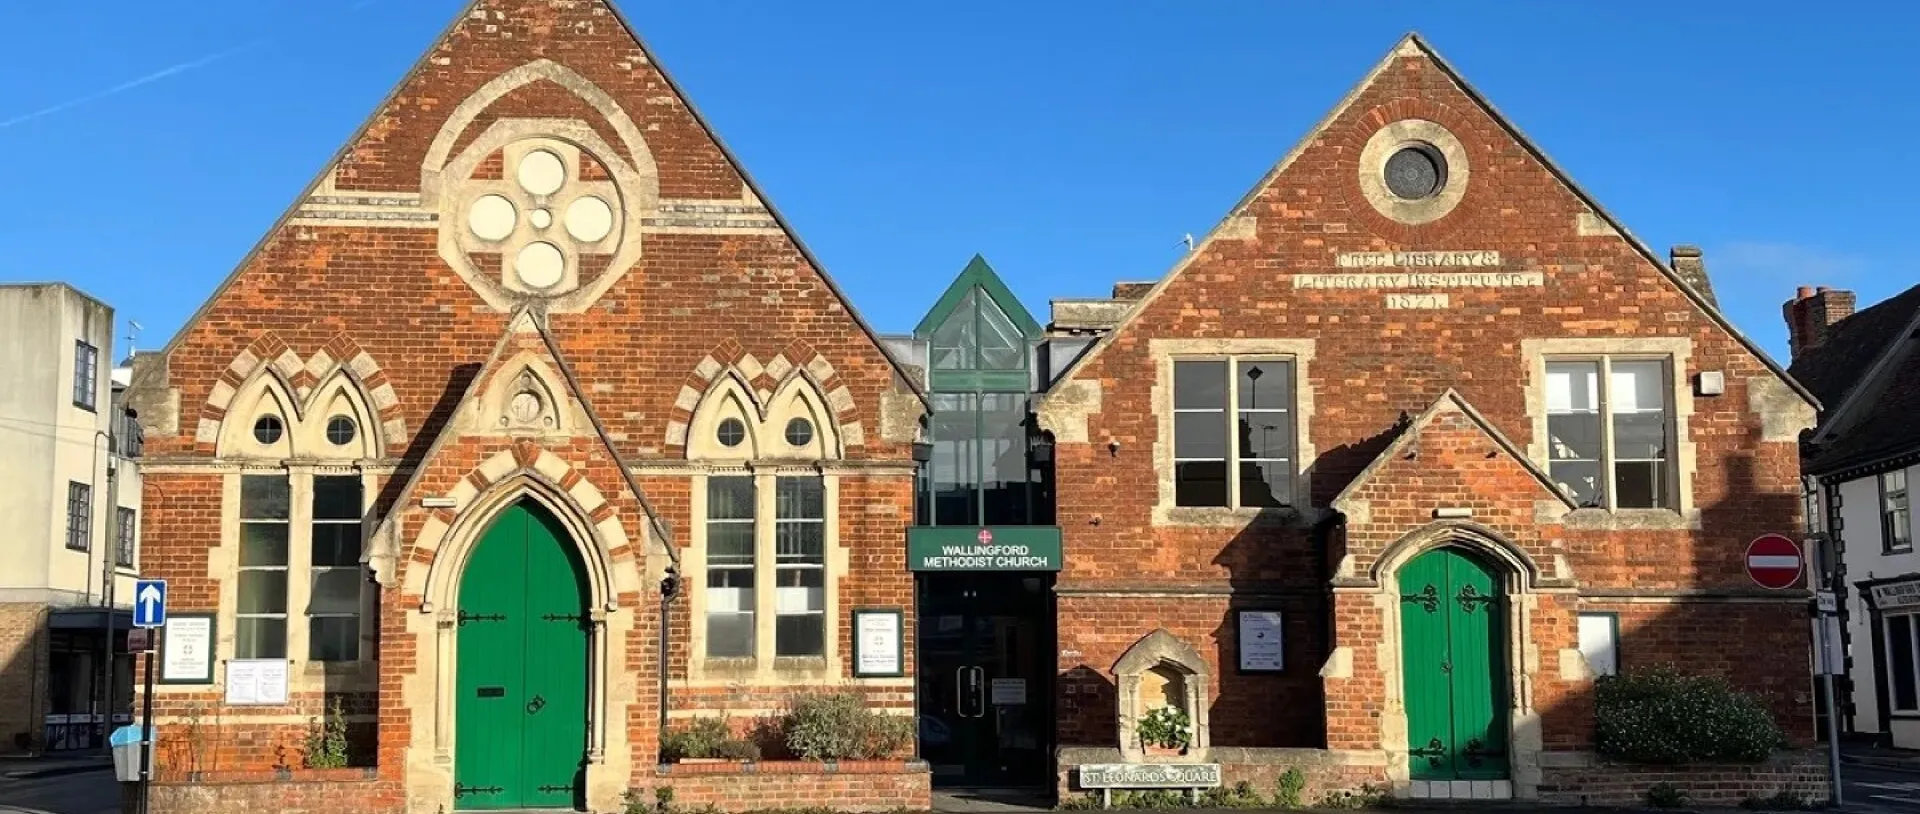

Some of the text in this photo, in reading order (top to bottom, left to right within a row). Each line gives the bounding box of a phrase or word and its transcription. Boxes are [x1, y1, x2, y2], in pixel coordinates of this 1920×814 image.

[1393, 252, 1476, 266] LIBRARY
[1480, 252, 1497, 266] &
[1296, 274, 1401, 289] LITERARY
[942, 545, 1029, 556] WALLINGFORD
[924, 556, 1048, 567] METHODIST CHURCH
[1169, 770, 1217, 783] SQUARE
